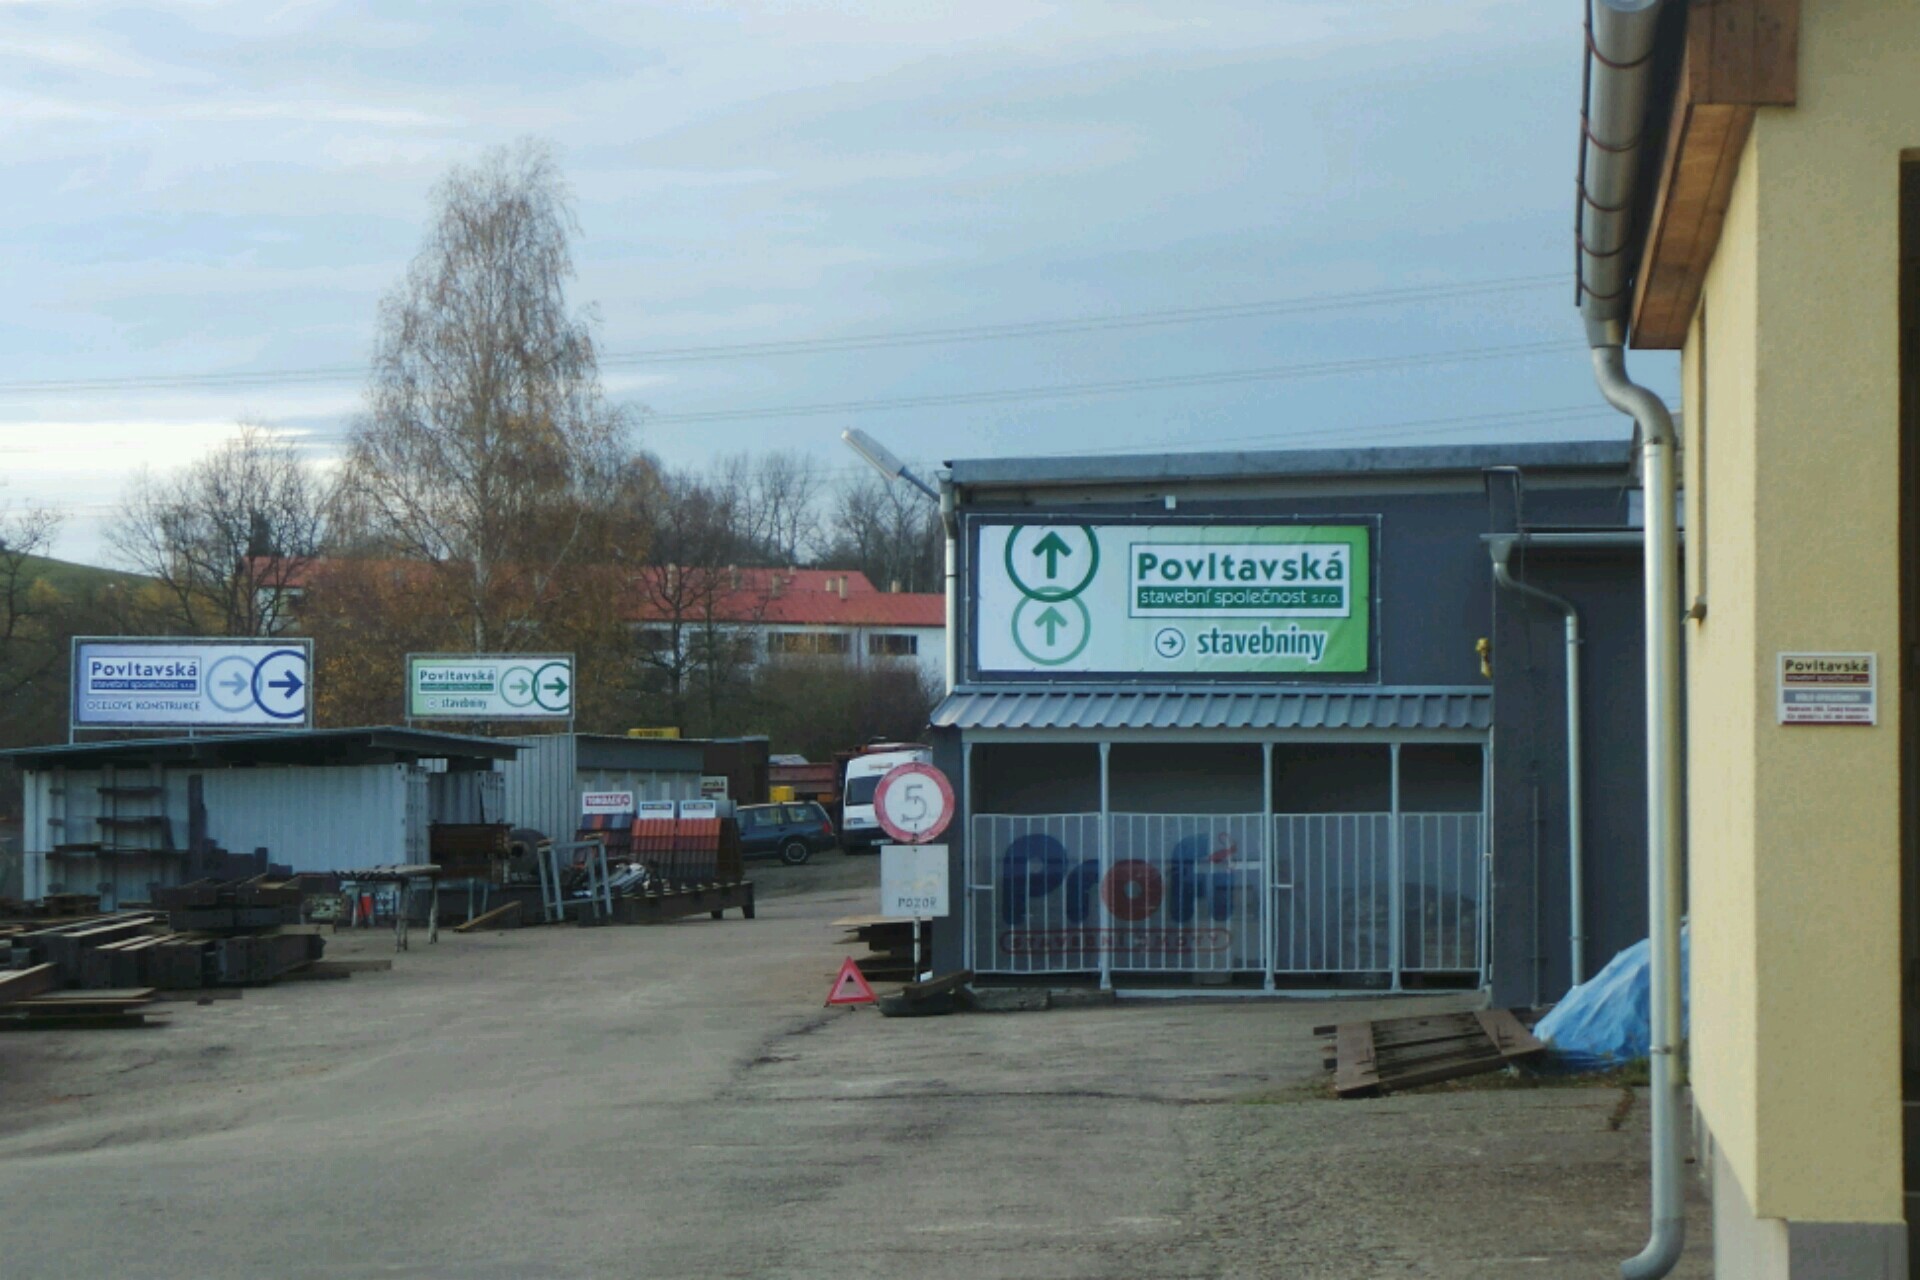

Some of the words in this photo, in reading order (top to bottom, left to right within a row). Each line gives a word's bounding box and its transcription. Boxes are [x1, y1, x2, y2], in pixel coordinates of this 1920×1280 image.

[1137, 550, 1344, 581] Povltavská
[1140, 588, 1211, 604] stavební
[1214, 588, 1307, 607] společnost
[1311, 593, 1341, 604] s.r.o.
[1197, 625, 1325, 661] stavebniny
[91, 660, 197, 677] Povltavská
[1785, 659, 1870, 672] Povltavská
[420, 669, 495, 681] Povltavská
[900, 783, 928, 823] 5
[898, 896, 938, 908] POZOR
